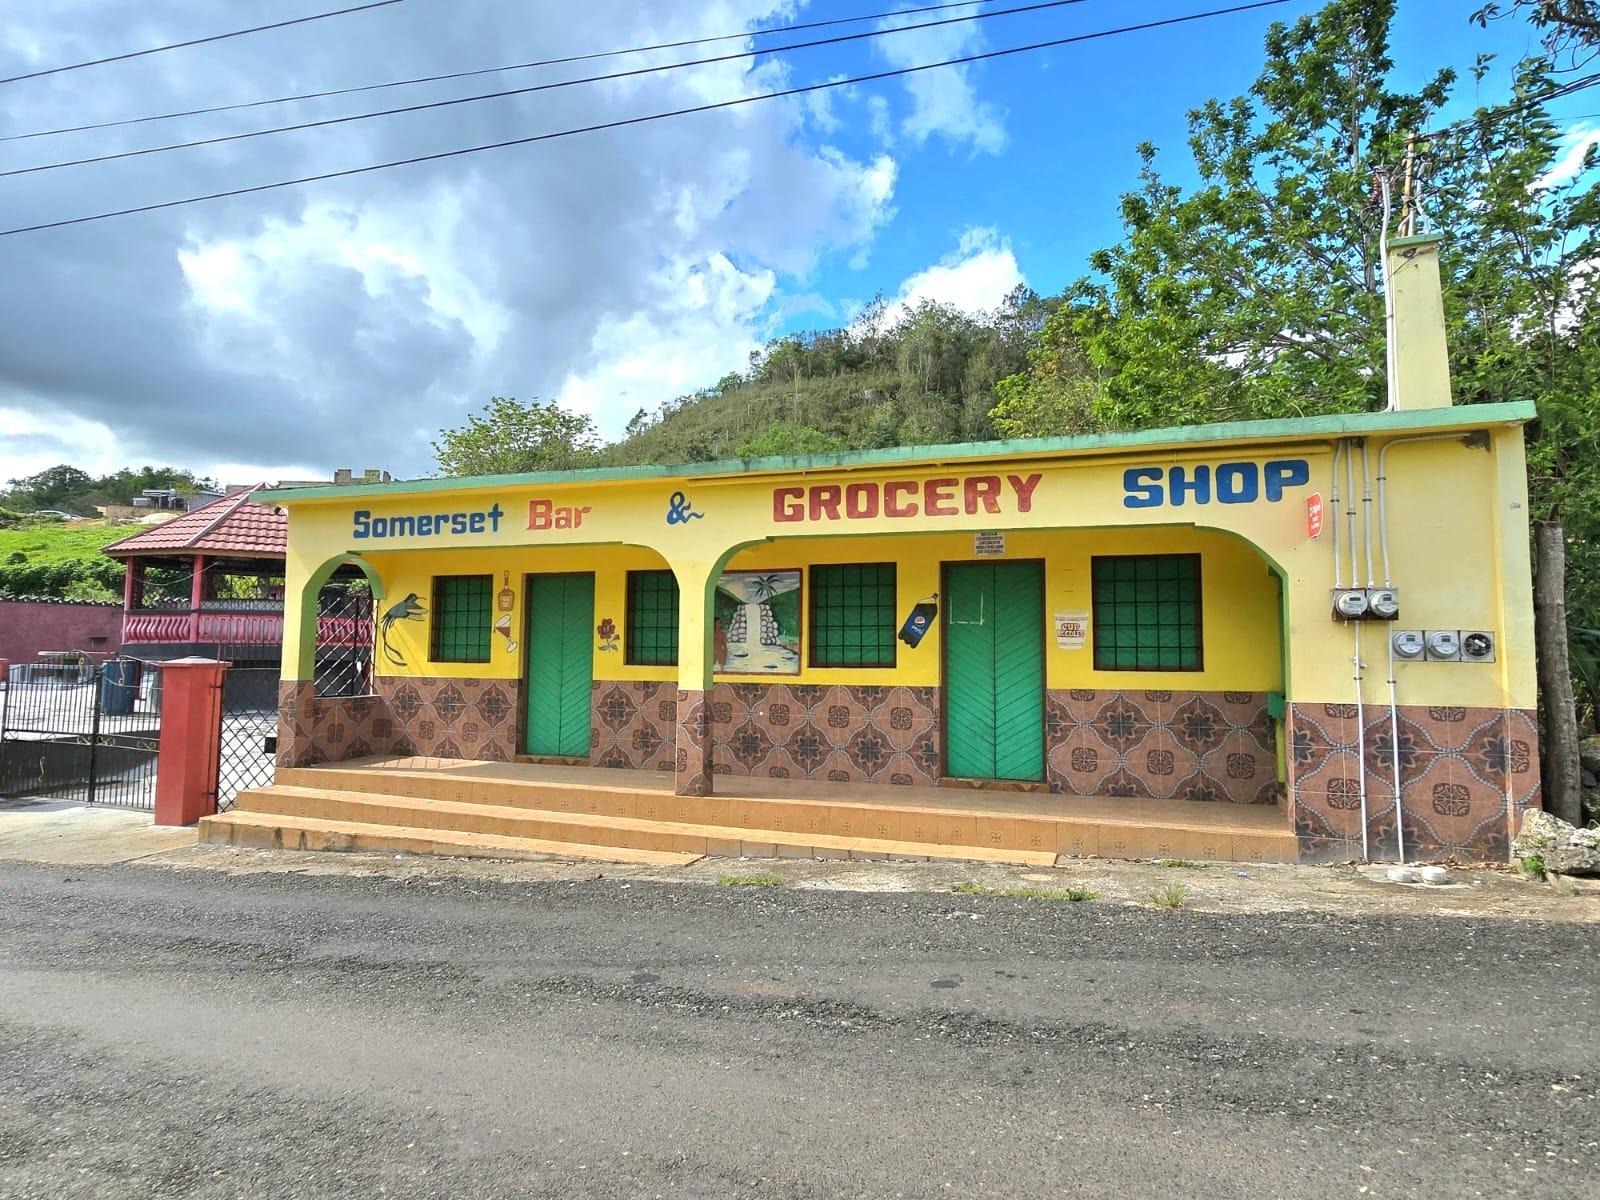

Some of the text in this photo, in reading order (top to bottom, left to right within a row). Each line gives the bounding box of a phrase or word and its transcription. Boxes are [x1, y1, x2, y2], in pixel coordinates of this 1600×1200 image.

[353, 459, 1309, 539] Somerset Bar & GROCERY SHOP
